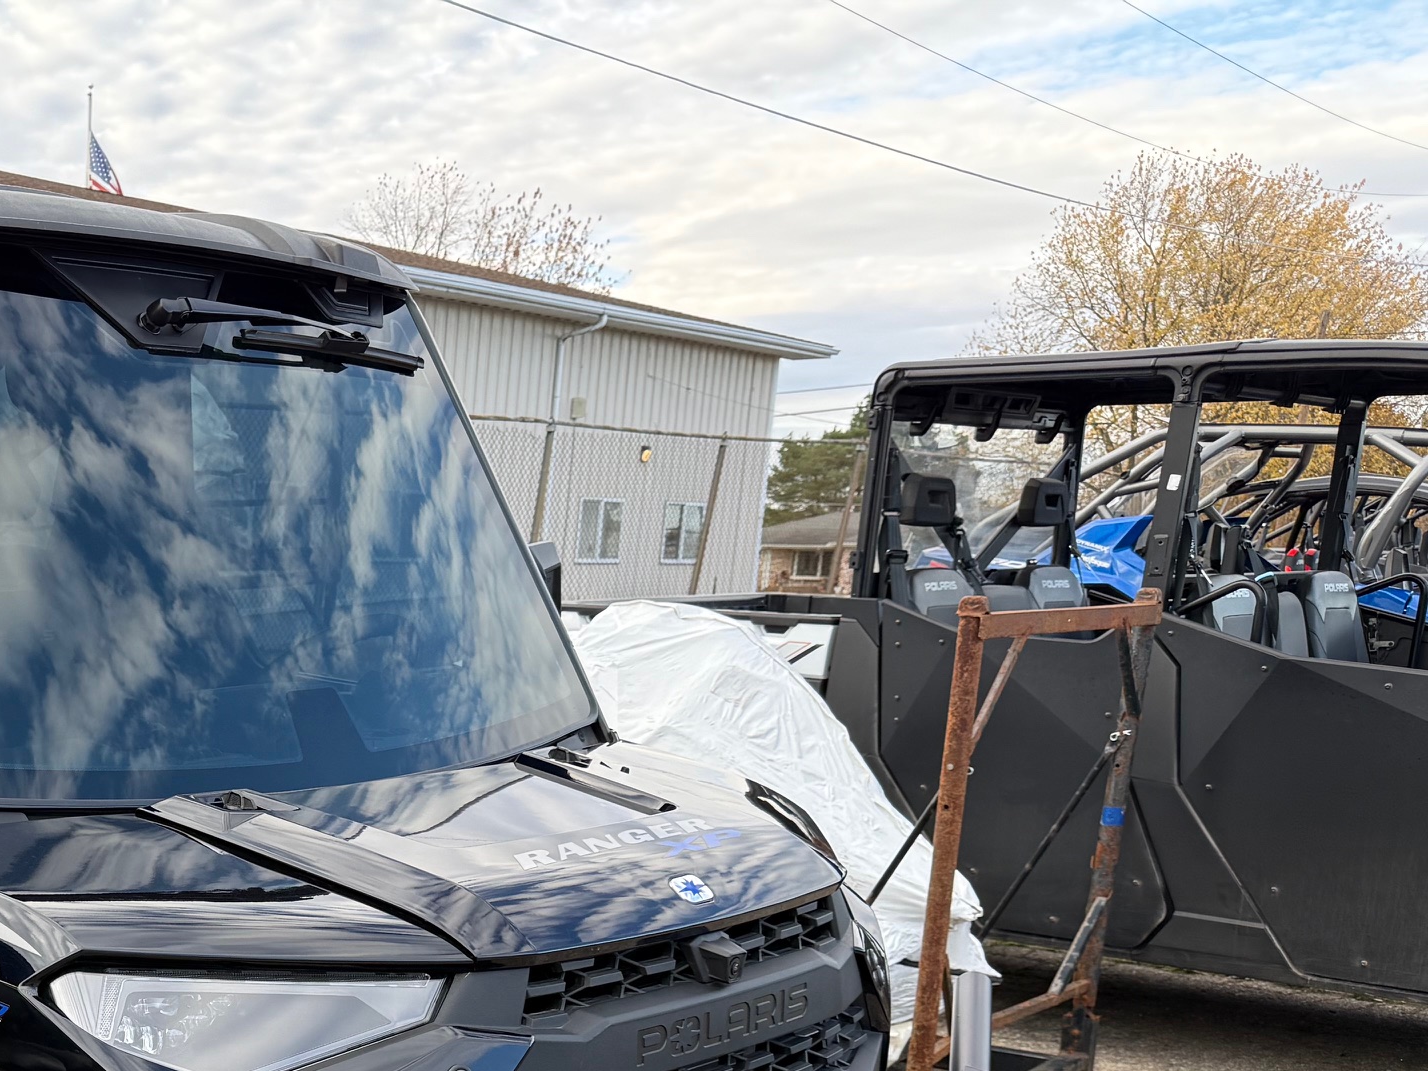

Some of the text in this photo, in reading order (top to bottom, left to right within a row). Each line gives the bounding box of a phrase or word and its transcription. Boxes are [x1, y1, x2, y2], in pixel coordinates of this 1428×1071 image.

[924, 580, 958, 592] POLARIS
[1041, 579, 1071, 589] POLARIS
[1324, 583, 1349, 593] POLARIS
[513, 818, 715, 871] RANGER
[654, 828, 743, 858] XP
[636, 982, 809, 1067] POLARIS
